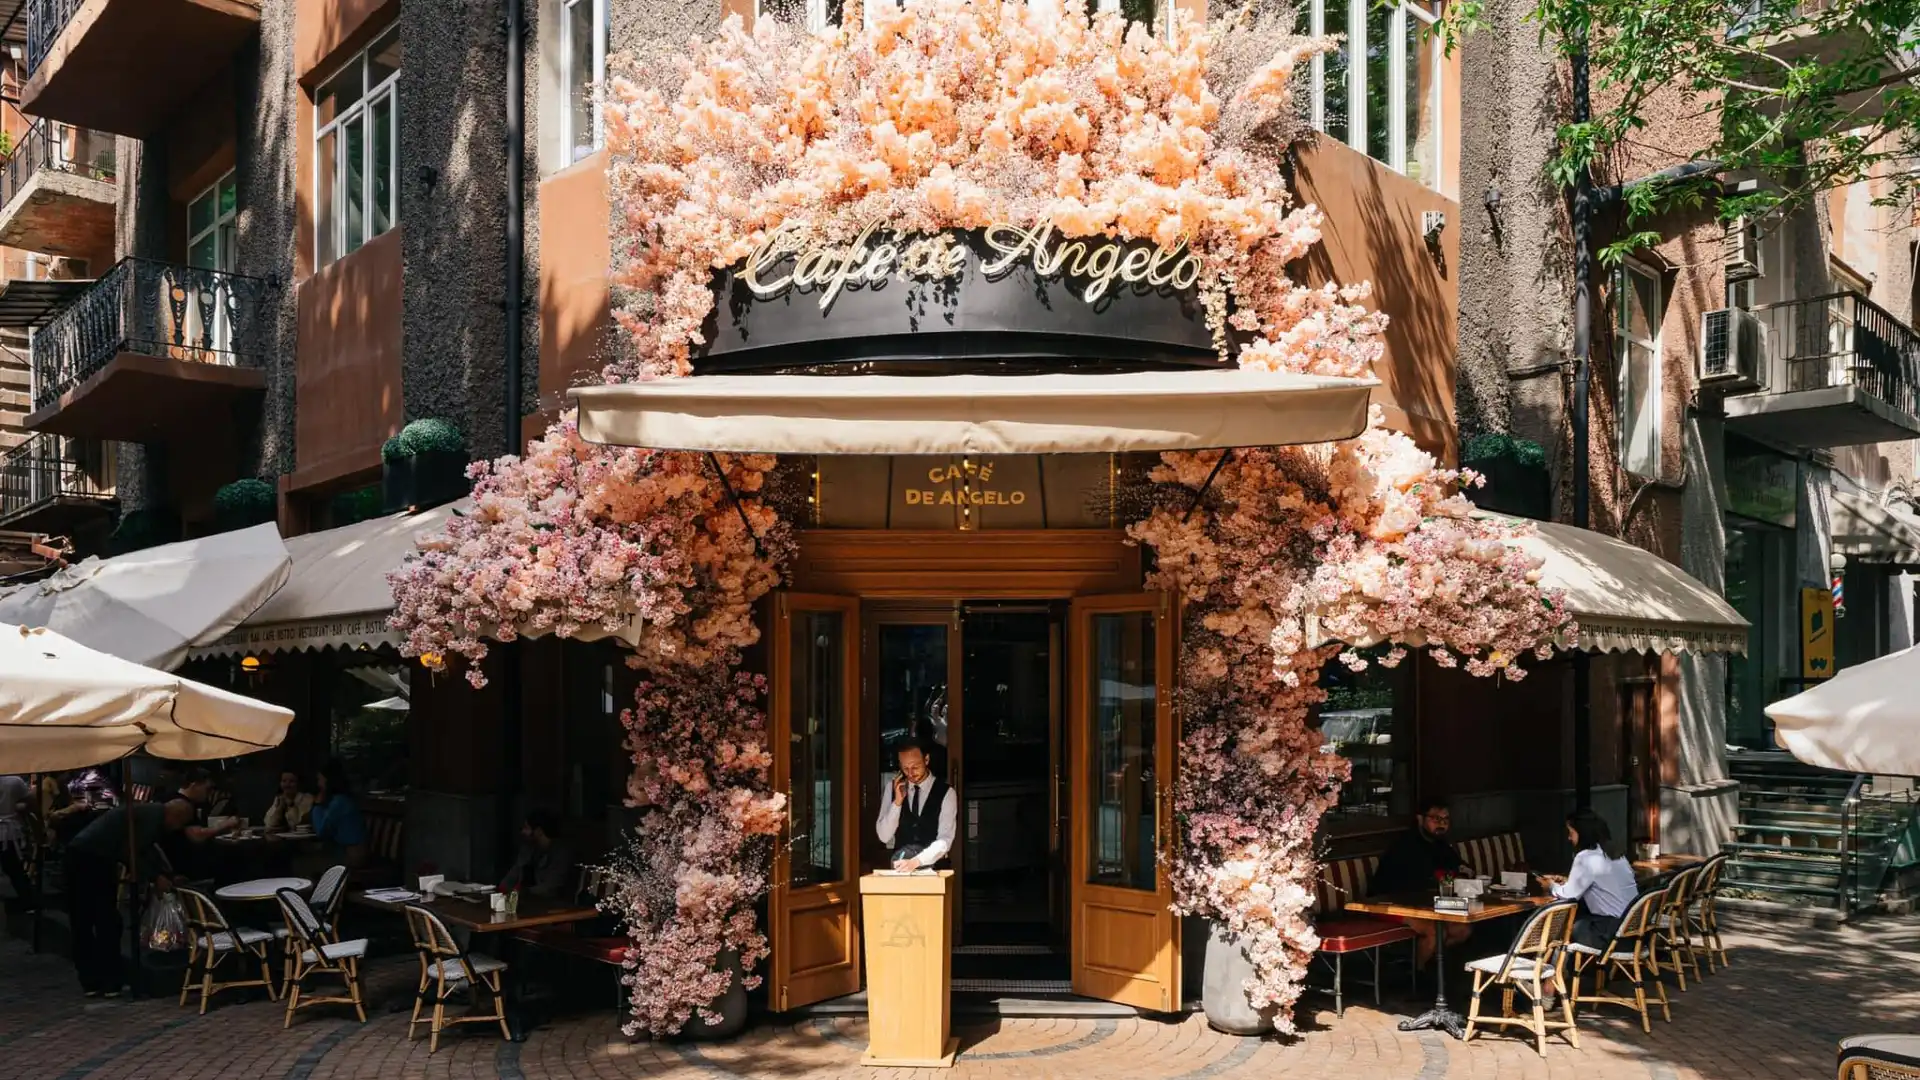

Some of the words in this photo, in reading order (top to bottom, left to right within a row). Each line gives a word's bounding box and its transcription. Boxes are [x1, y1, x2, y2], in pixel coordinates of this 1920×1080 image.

[979, 215, 1202, 303] Angelo
[928, 461, 994, 483] CAFÉ
[905, 489, 935, 505] DE
[938, 490, 1026, 505] ANGELO
[299, 624, 329, 639] RESTAURANT
[1578, 623, 1612, 638] ESTAURANT
